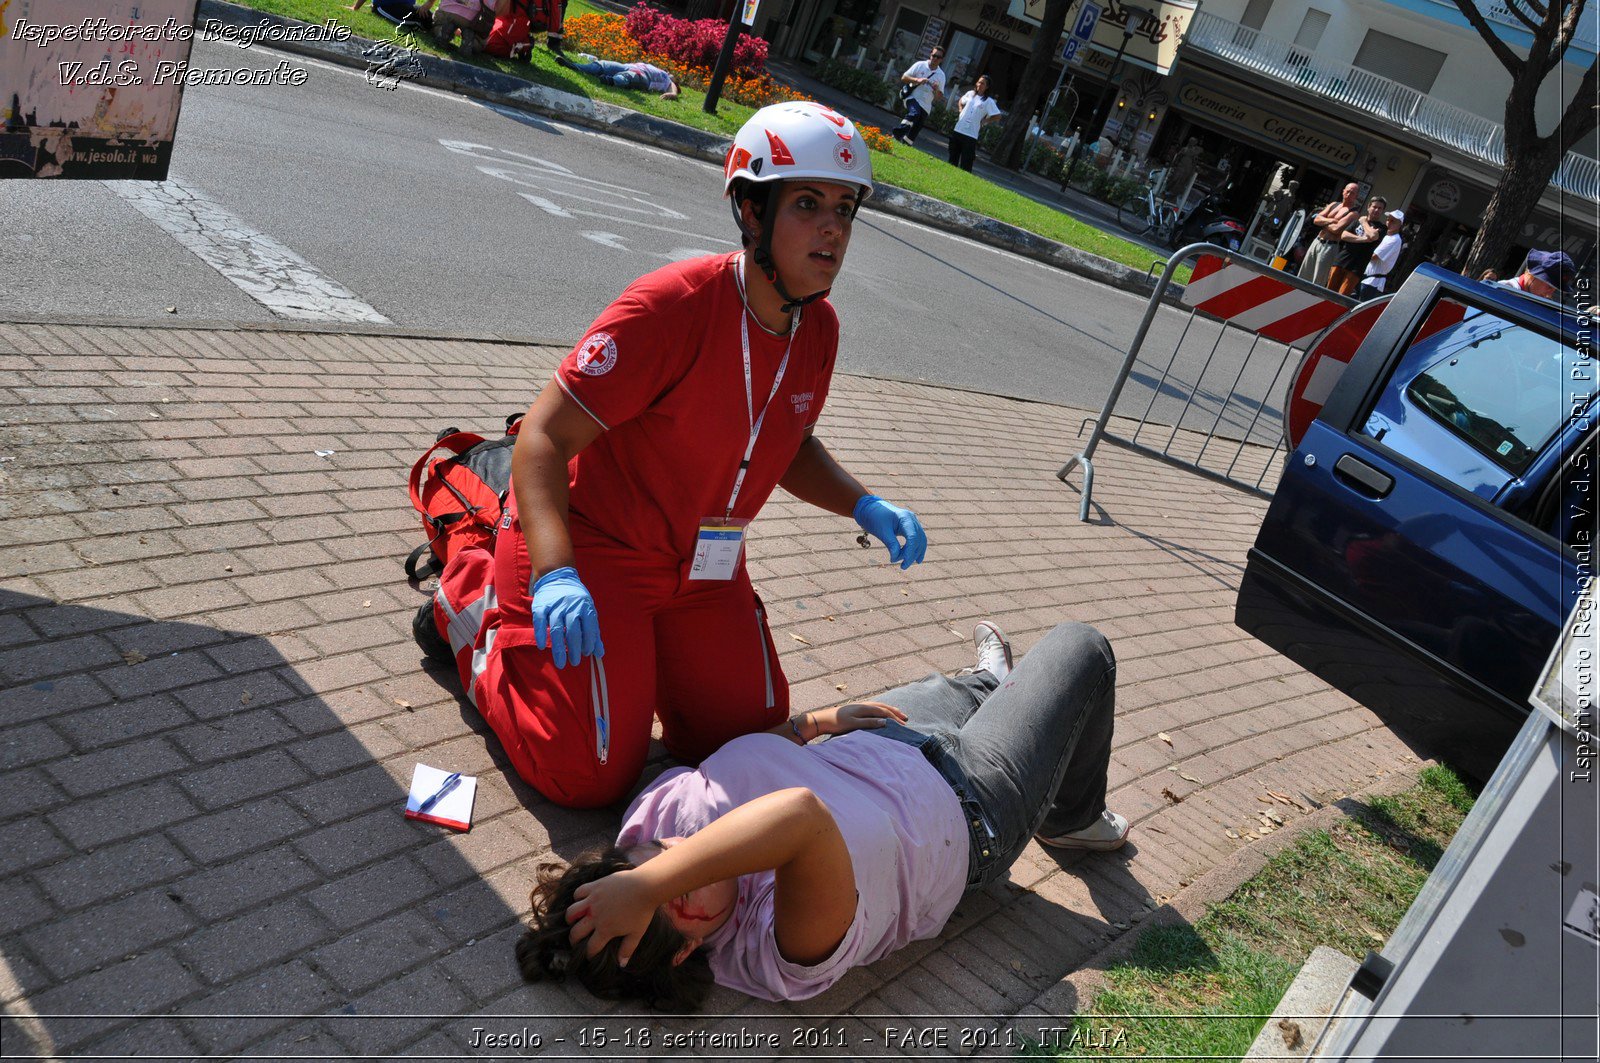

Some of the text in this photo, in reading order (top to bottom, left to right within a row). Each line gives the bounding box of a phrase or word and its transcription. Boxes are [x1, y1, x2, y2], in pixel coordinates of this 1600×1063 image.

[974, 20, 1010, 42] Bistrò
[1080, 11, 1093, 31] P
[1066, 41, 1076, 58] P
[1088, 52, 1114, 70] Bar
[1184, 86, 1351, 162] Cremeria Caffetteria
